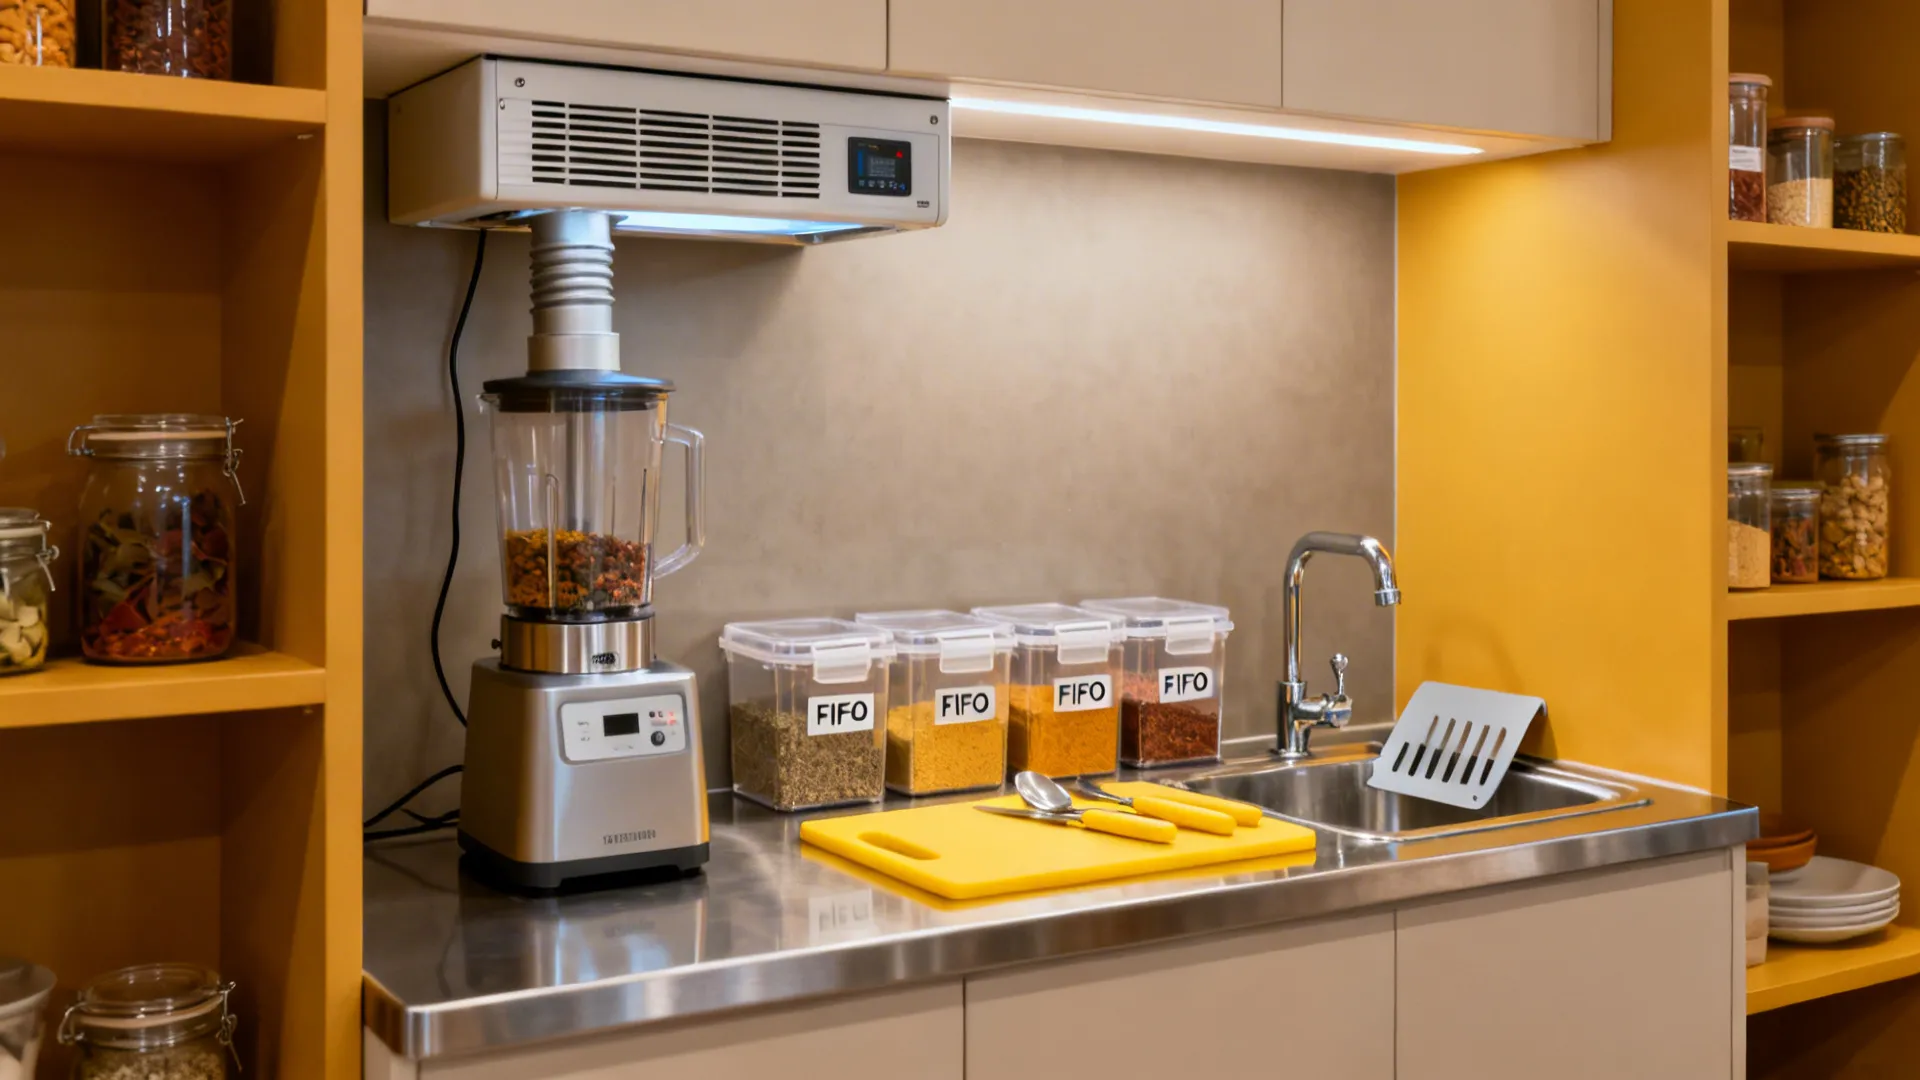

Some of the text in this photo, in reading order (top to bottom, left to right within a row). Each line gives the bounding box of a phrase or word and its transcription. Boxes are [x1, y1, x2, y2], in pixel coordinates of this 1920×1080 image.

[1058, 681, 1106, 706] FIFO
[1164, 672, 1208, 695] FIFO
[817, 701, 868, 726] FIFO
[942, 692, 989, 717] FIFO
